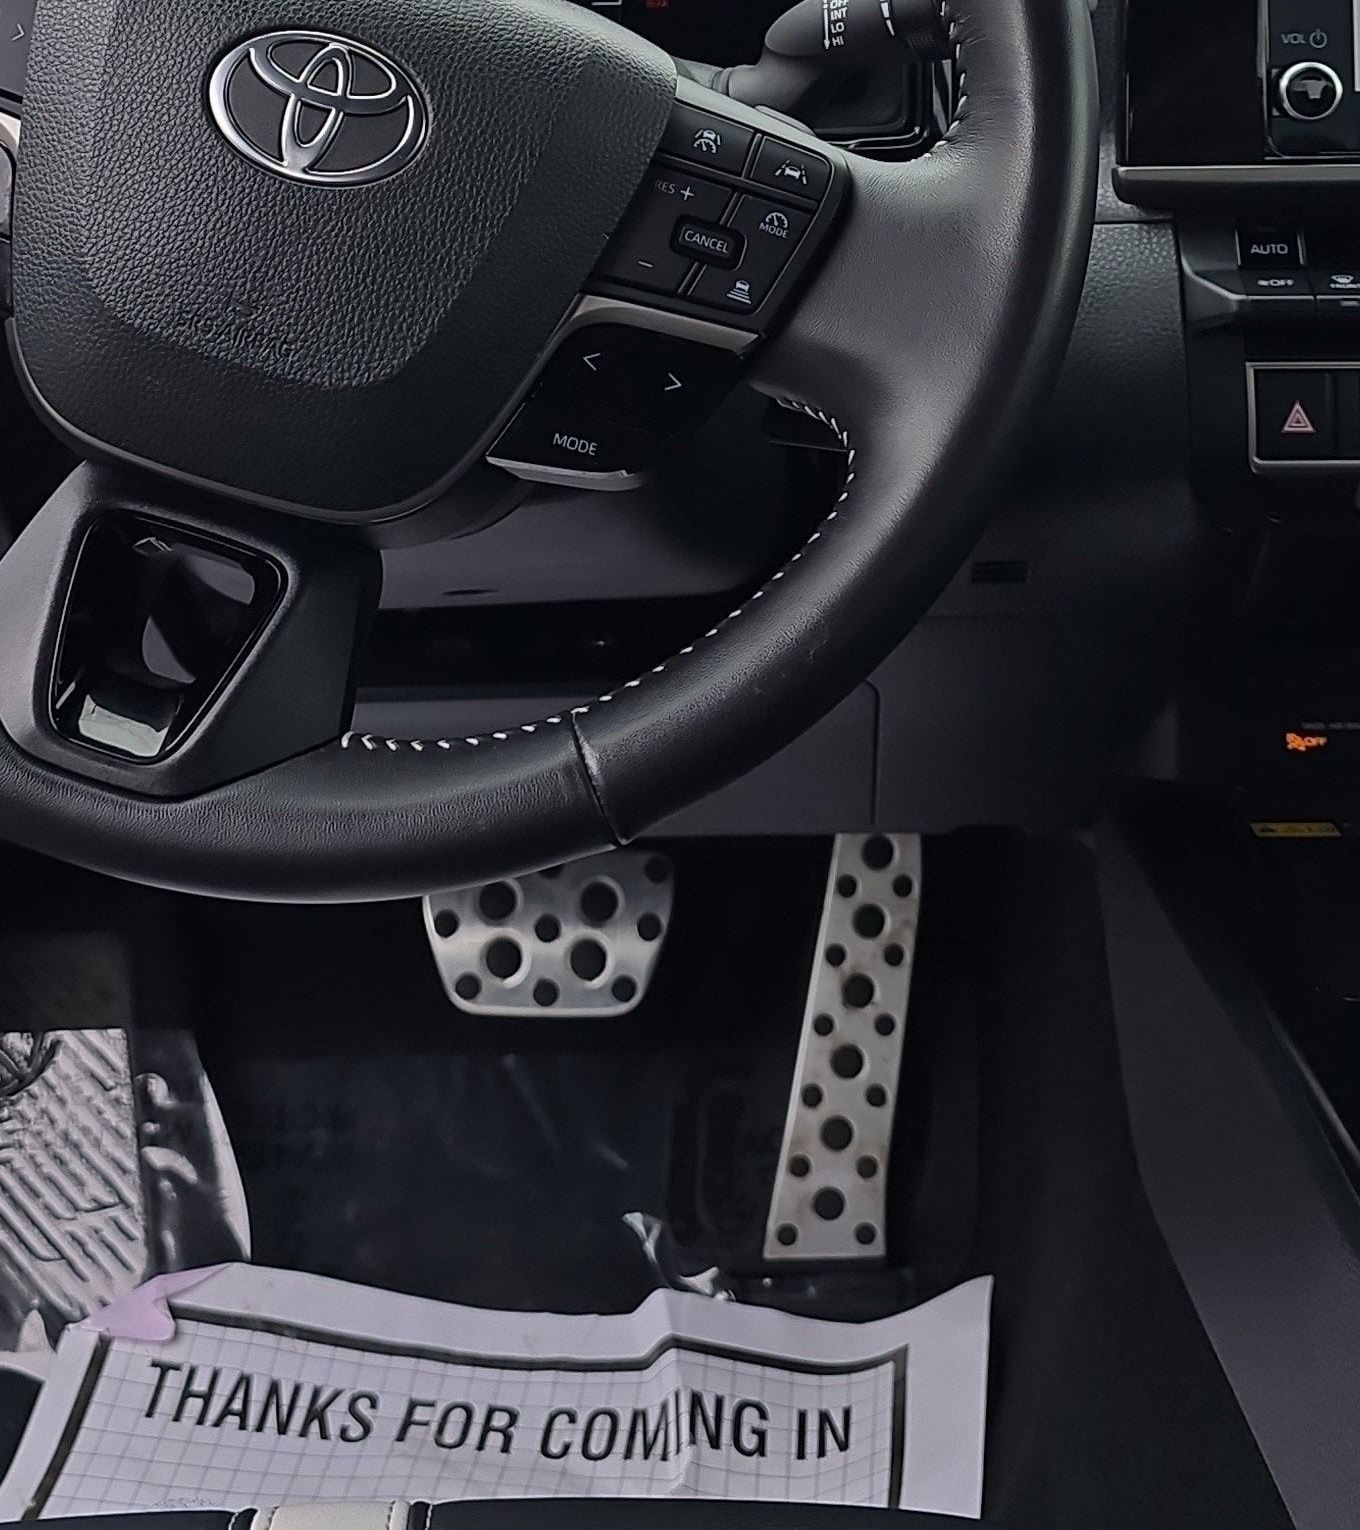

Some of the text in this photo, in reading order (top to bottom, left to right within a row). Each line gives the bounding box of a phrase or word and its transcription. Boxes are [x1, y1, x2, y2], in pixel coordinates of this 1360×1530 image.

[830, 7, 848, 20] INT
[830, 21, 845, 34] LO
[832, 36, 845, 47] HI
[1281, 33, 1306, 44] VOL
[759, 221, 789, 239] MODE
[684, 229, 729, 254] CANCEL
[1250, 243, 1288, 254] AUTO
[553, 433, 597, 456] MODE
[144, 1358, 852, 1462] THANKS FOR COMING IN
